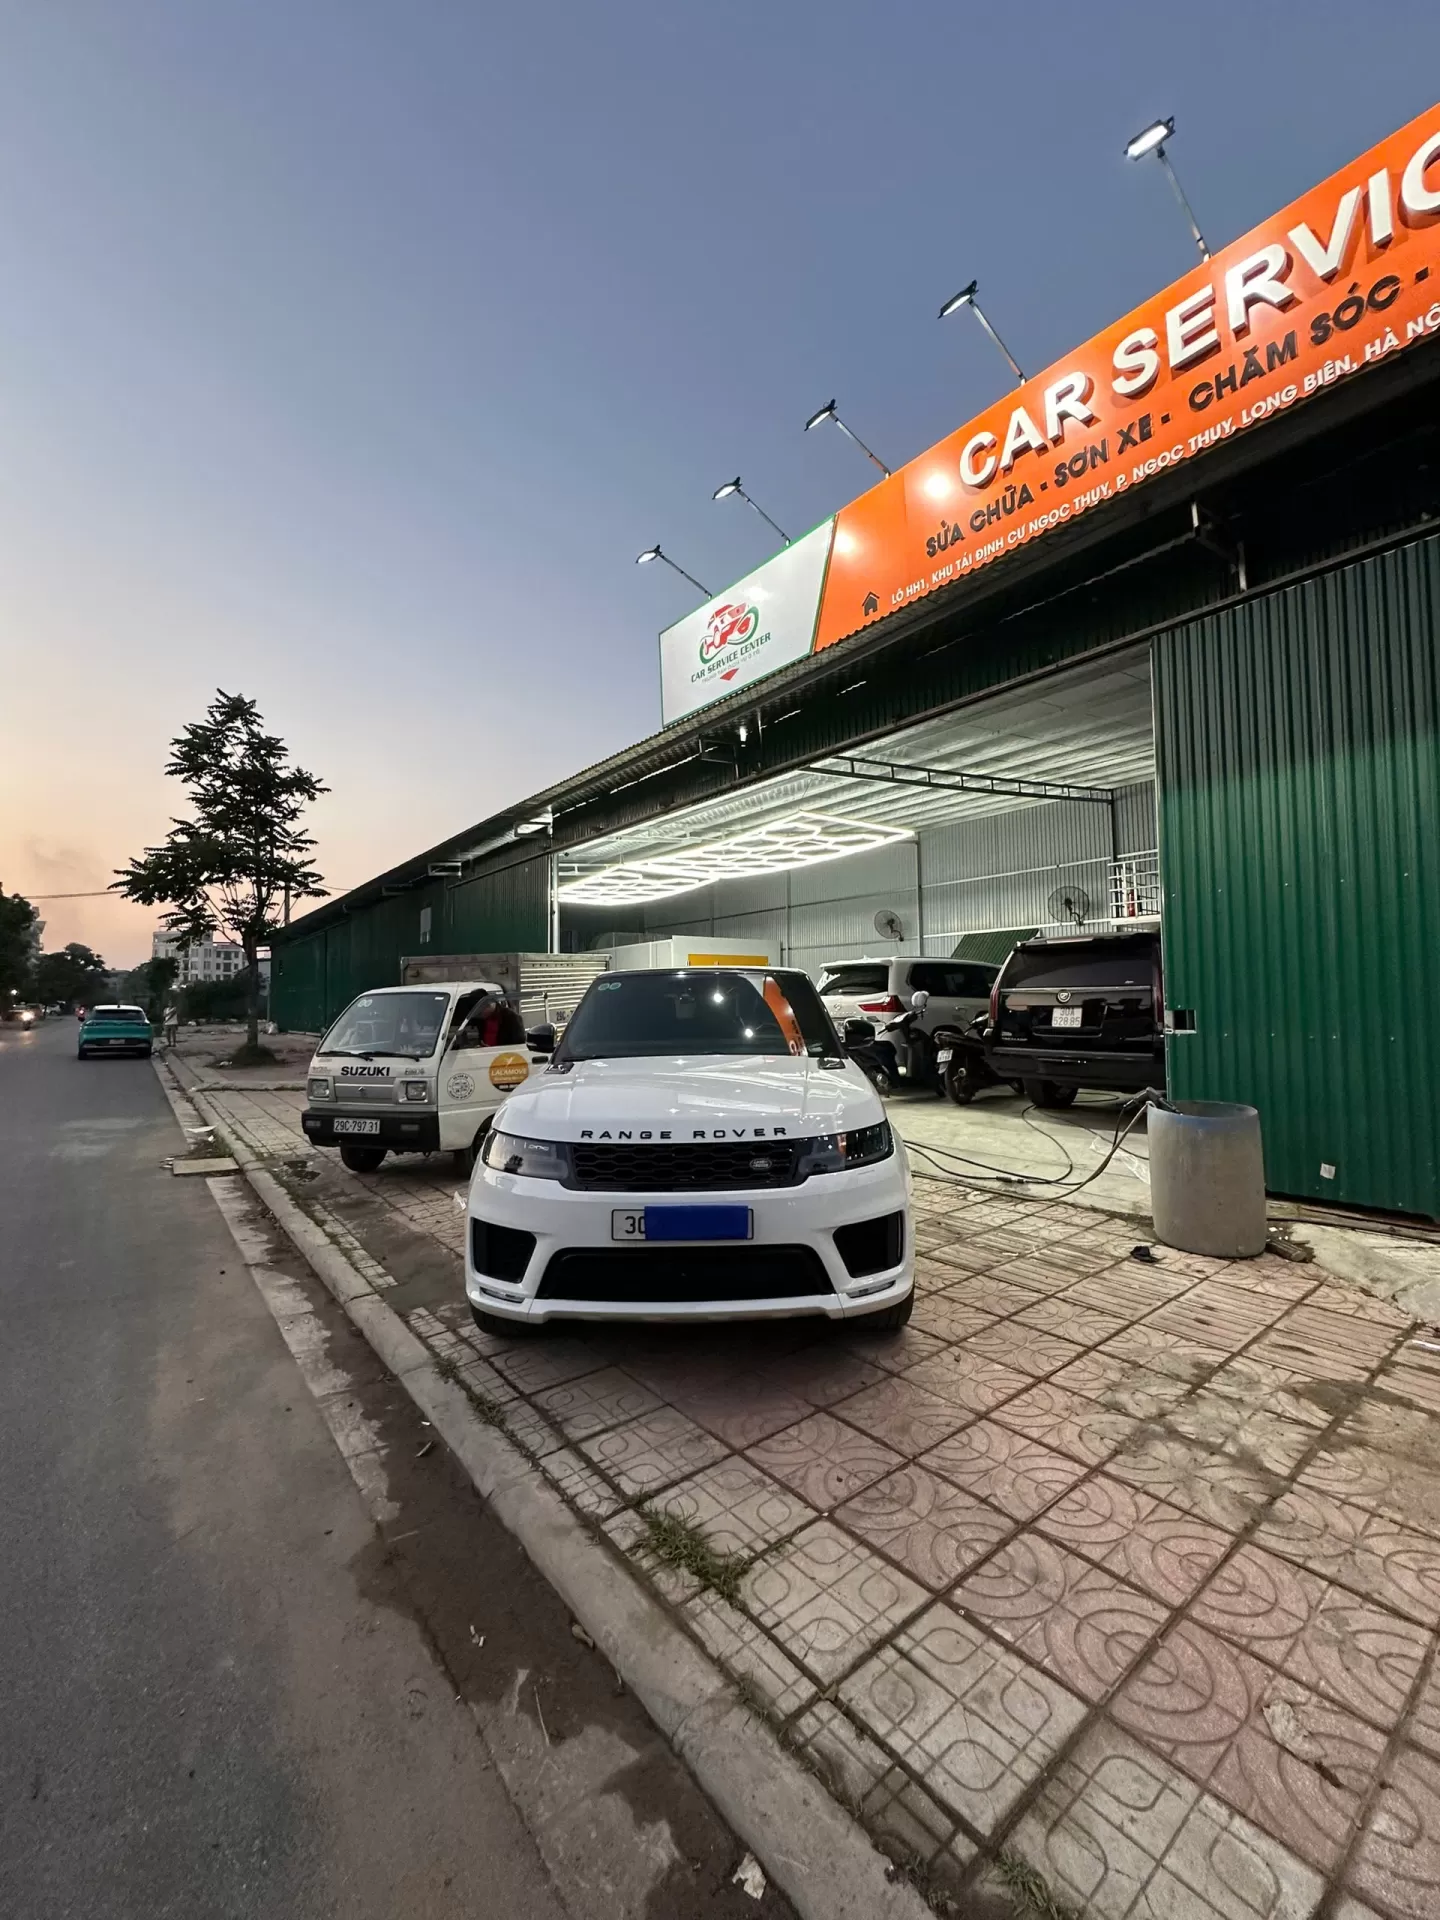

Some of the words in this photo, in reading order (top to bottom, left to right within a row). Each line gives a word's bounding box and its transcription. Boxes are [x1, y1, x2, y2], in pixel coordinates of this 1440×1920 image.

[926, 520, 966, 557] SỬA
[970, 484, 1034, 532] CHỮA
[1054, 439, 1109, 487] SƠN
[1117, 413, 1152, 455] XE
[1189, 330, 1298, 412] CHĂM
[1310, 275, 1401, 345] SÓC
[960, 372, 1094, 489] CAR
[892, 587, 904, 605] LÔ
[906, 578, 930, 597] HH1,
[932, 563, 954, 584] KHU
[955, 551, 972, 571] TÁI
[975, 537, 1004, 561] ĐỊNH
[1007, 523, 1026, 543] CƯ
[1028, 503, 1070, 533] NGỌC
[1116, 474, 1128, 489] P.
[1242, 384, 1297, 424] LONG
[1304, 355, 1358, 392] BIÊN,
[1364, 326, 1400, 361] HÀ
[691, 669, 705, 683] CAR
[707, 650, 738, 674] SERVICE
[740, 632, 771, 655] CENTER
[341, 1066, 390, 1077] SUZUKI
[581, 1130, 672, 1139] RANGE
[693, 1127, 787, 1139] ROVER
